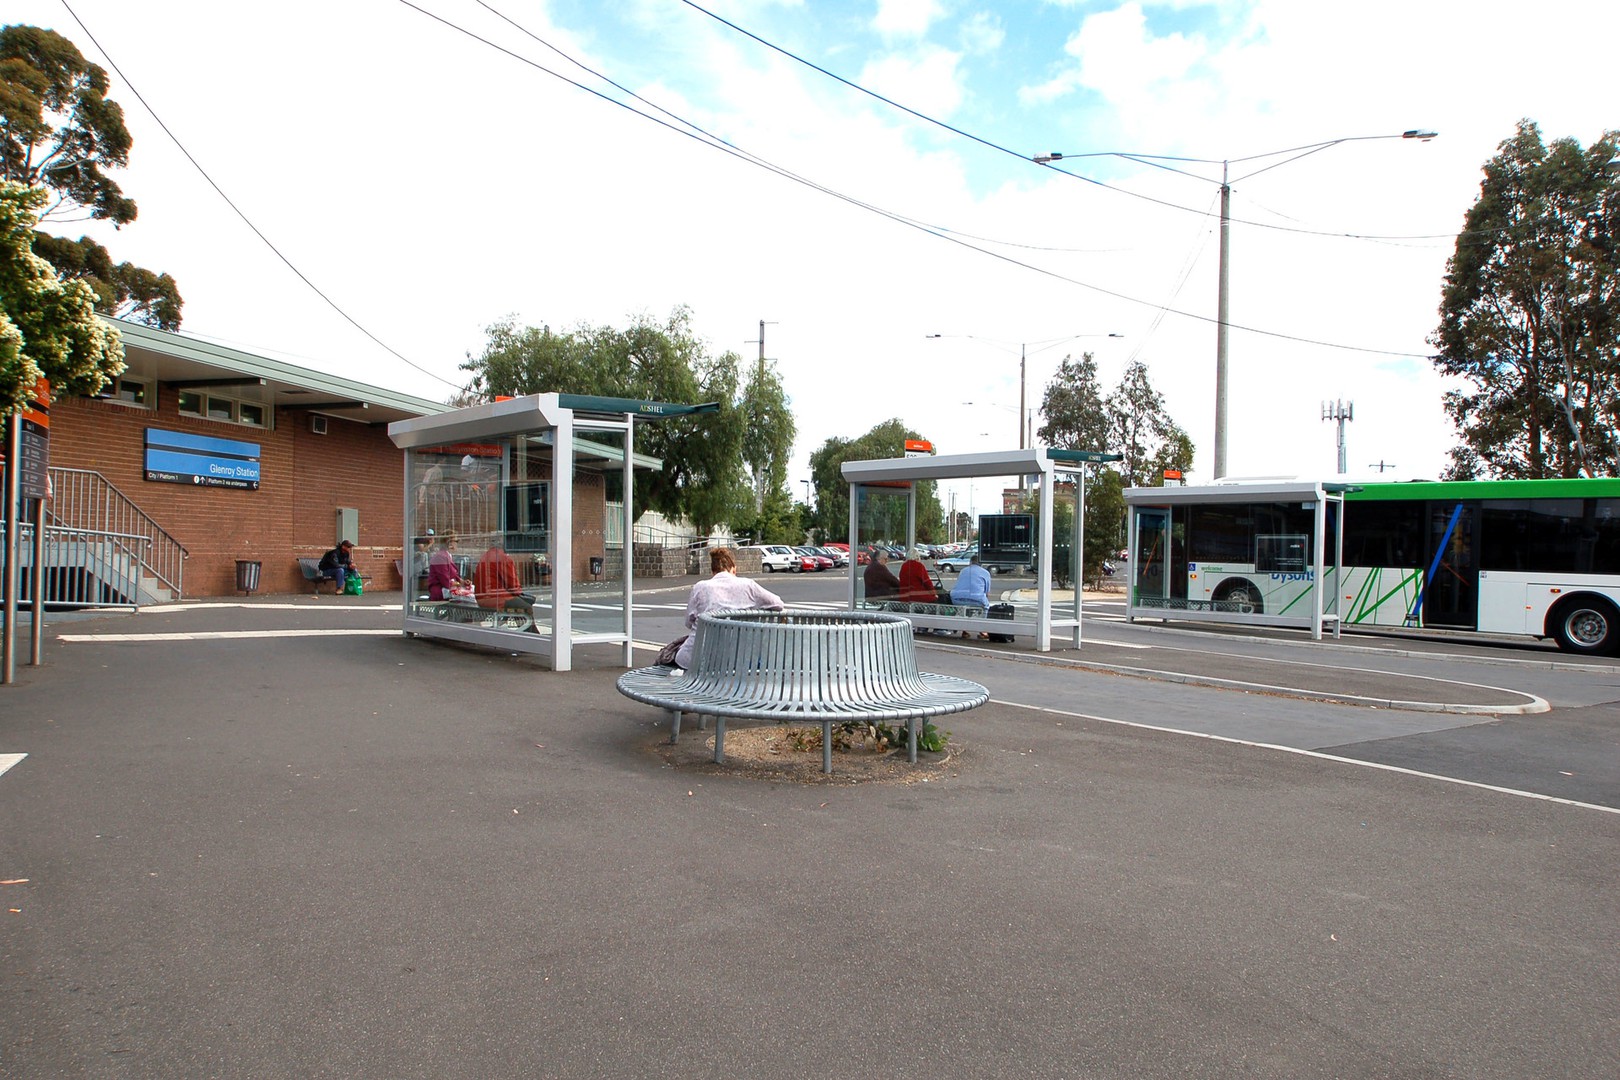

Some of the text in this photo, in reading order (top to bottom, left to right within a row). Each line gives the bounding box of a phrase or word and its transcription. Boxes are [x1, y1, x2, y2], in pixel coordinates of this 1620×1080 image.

[640, 404, 664, 414] ADSHEL
[209, 463, 259, 478] Glenroy Station
[148, 472, 157, 480] City
[208, 477, 222, 485] Platform
